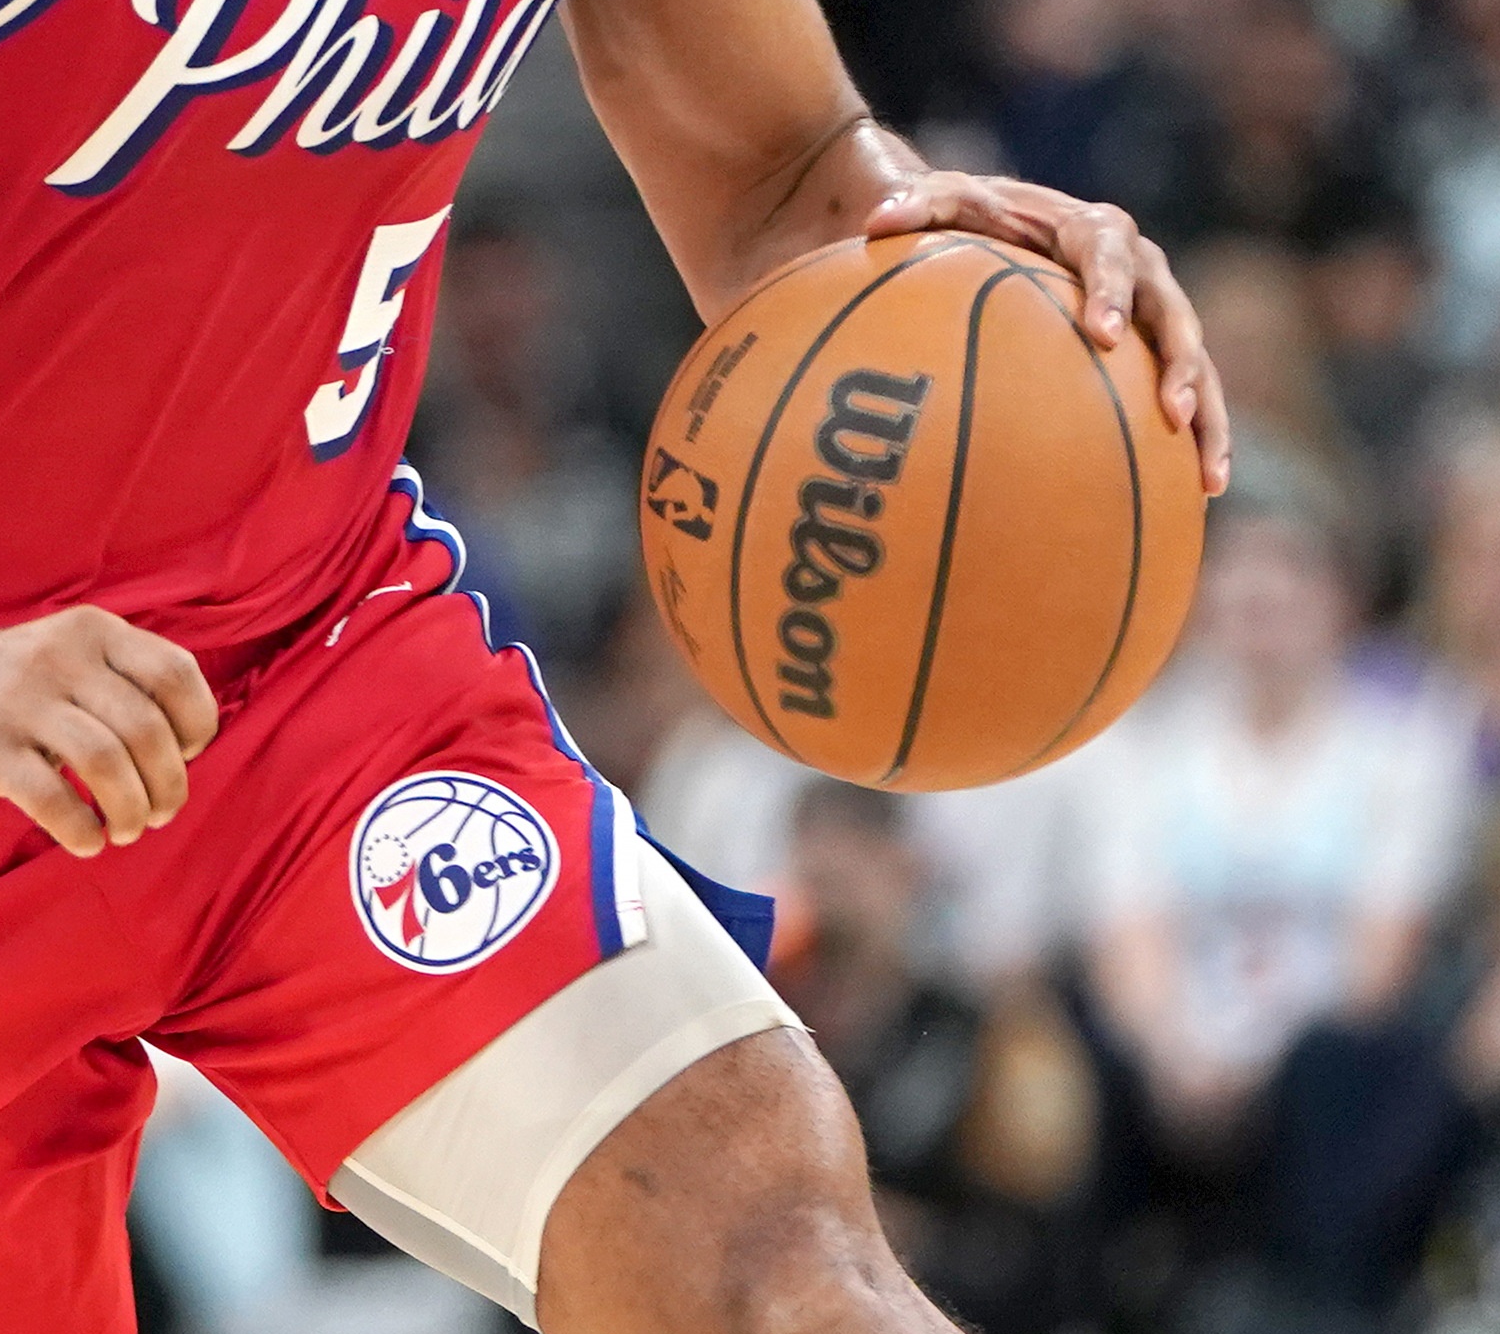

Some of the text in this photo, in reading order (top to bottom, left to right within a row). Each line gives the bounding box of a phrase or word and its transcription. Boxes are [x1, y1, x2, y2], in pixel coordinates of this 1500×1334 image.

[304, 203, 454, 464] 5
[777, 366, 935, 721] Wilson
[374, 843, 542, 948] 76ers
